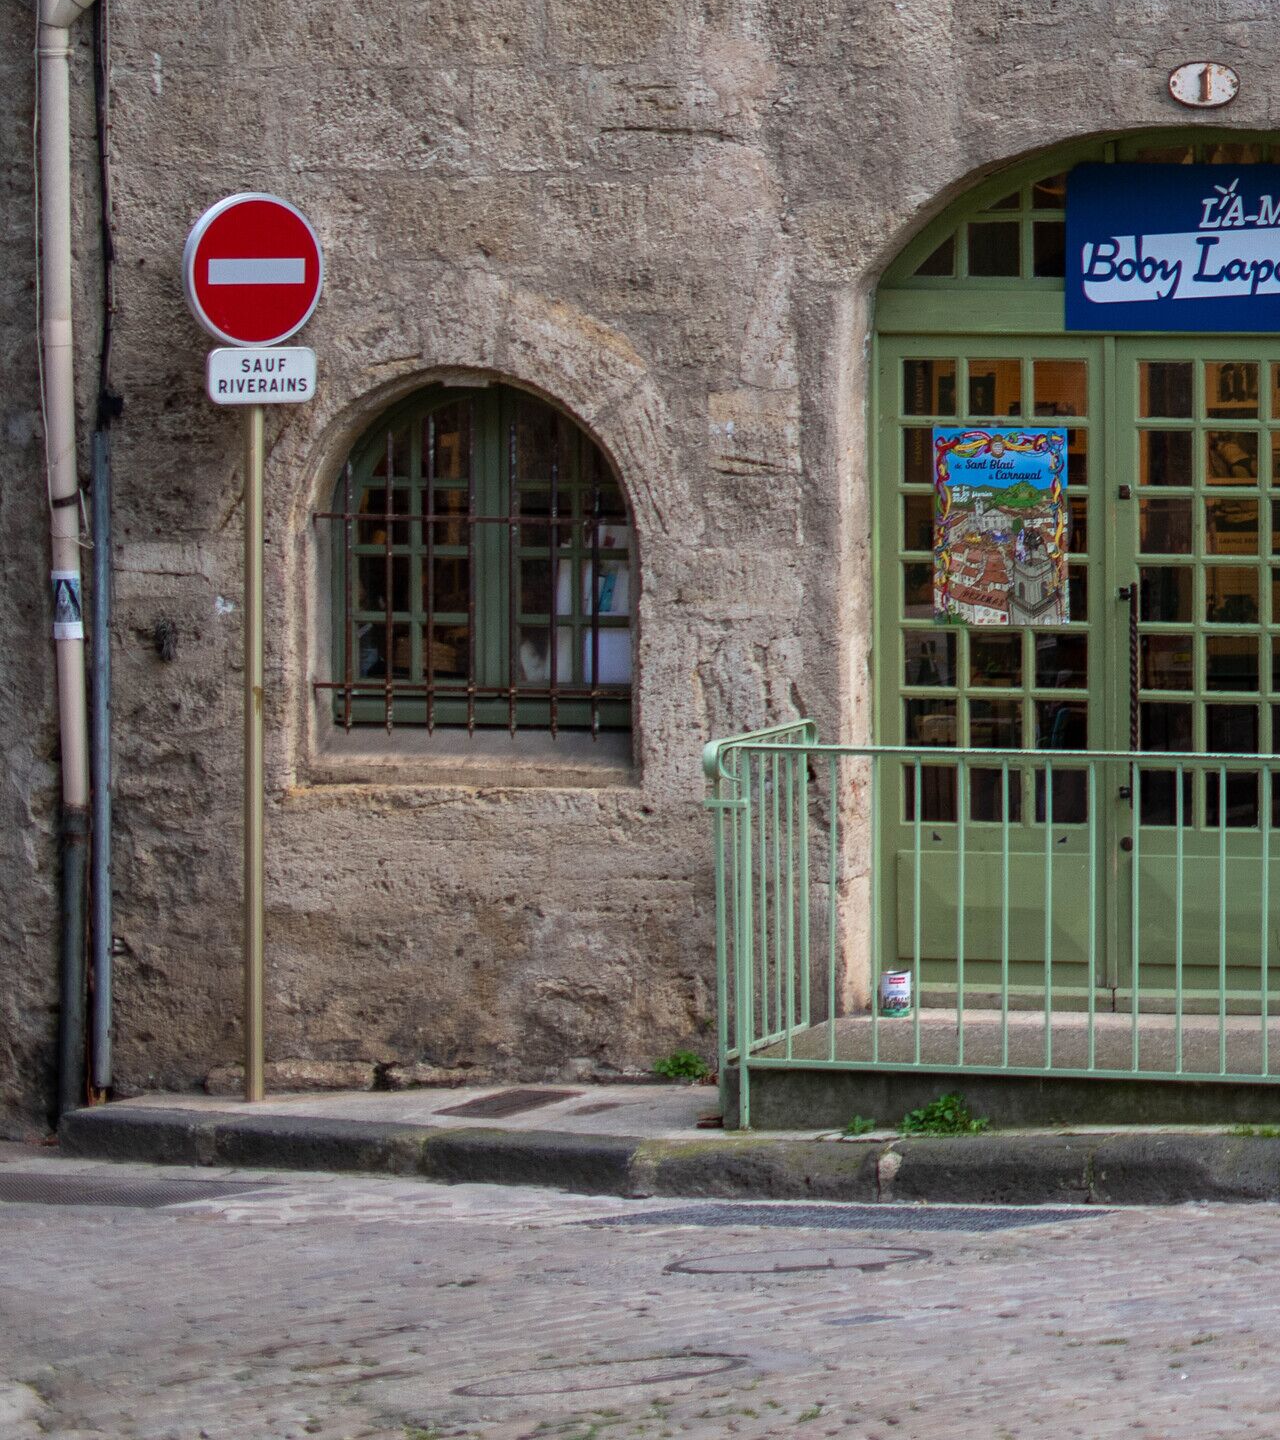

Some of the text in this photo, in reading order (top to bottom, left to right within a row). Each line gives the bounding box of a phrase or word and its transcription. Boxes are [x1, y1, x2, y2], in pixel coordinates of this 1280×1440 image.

[1197, 62, 1214, 101] 1
[1083, 235, 1183, 300] Boby
[242, 358, 287, 373] SAUF
[218, 378, 308, 394] RIVERAINS
[965, 459, 987, 469] Sant
[995, 470, 1042, 480] Carnaval
